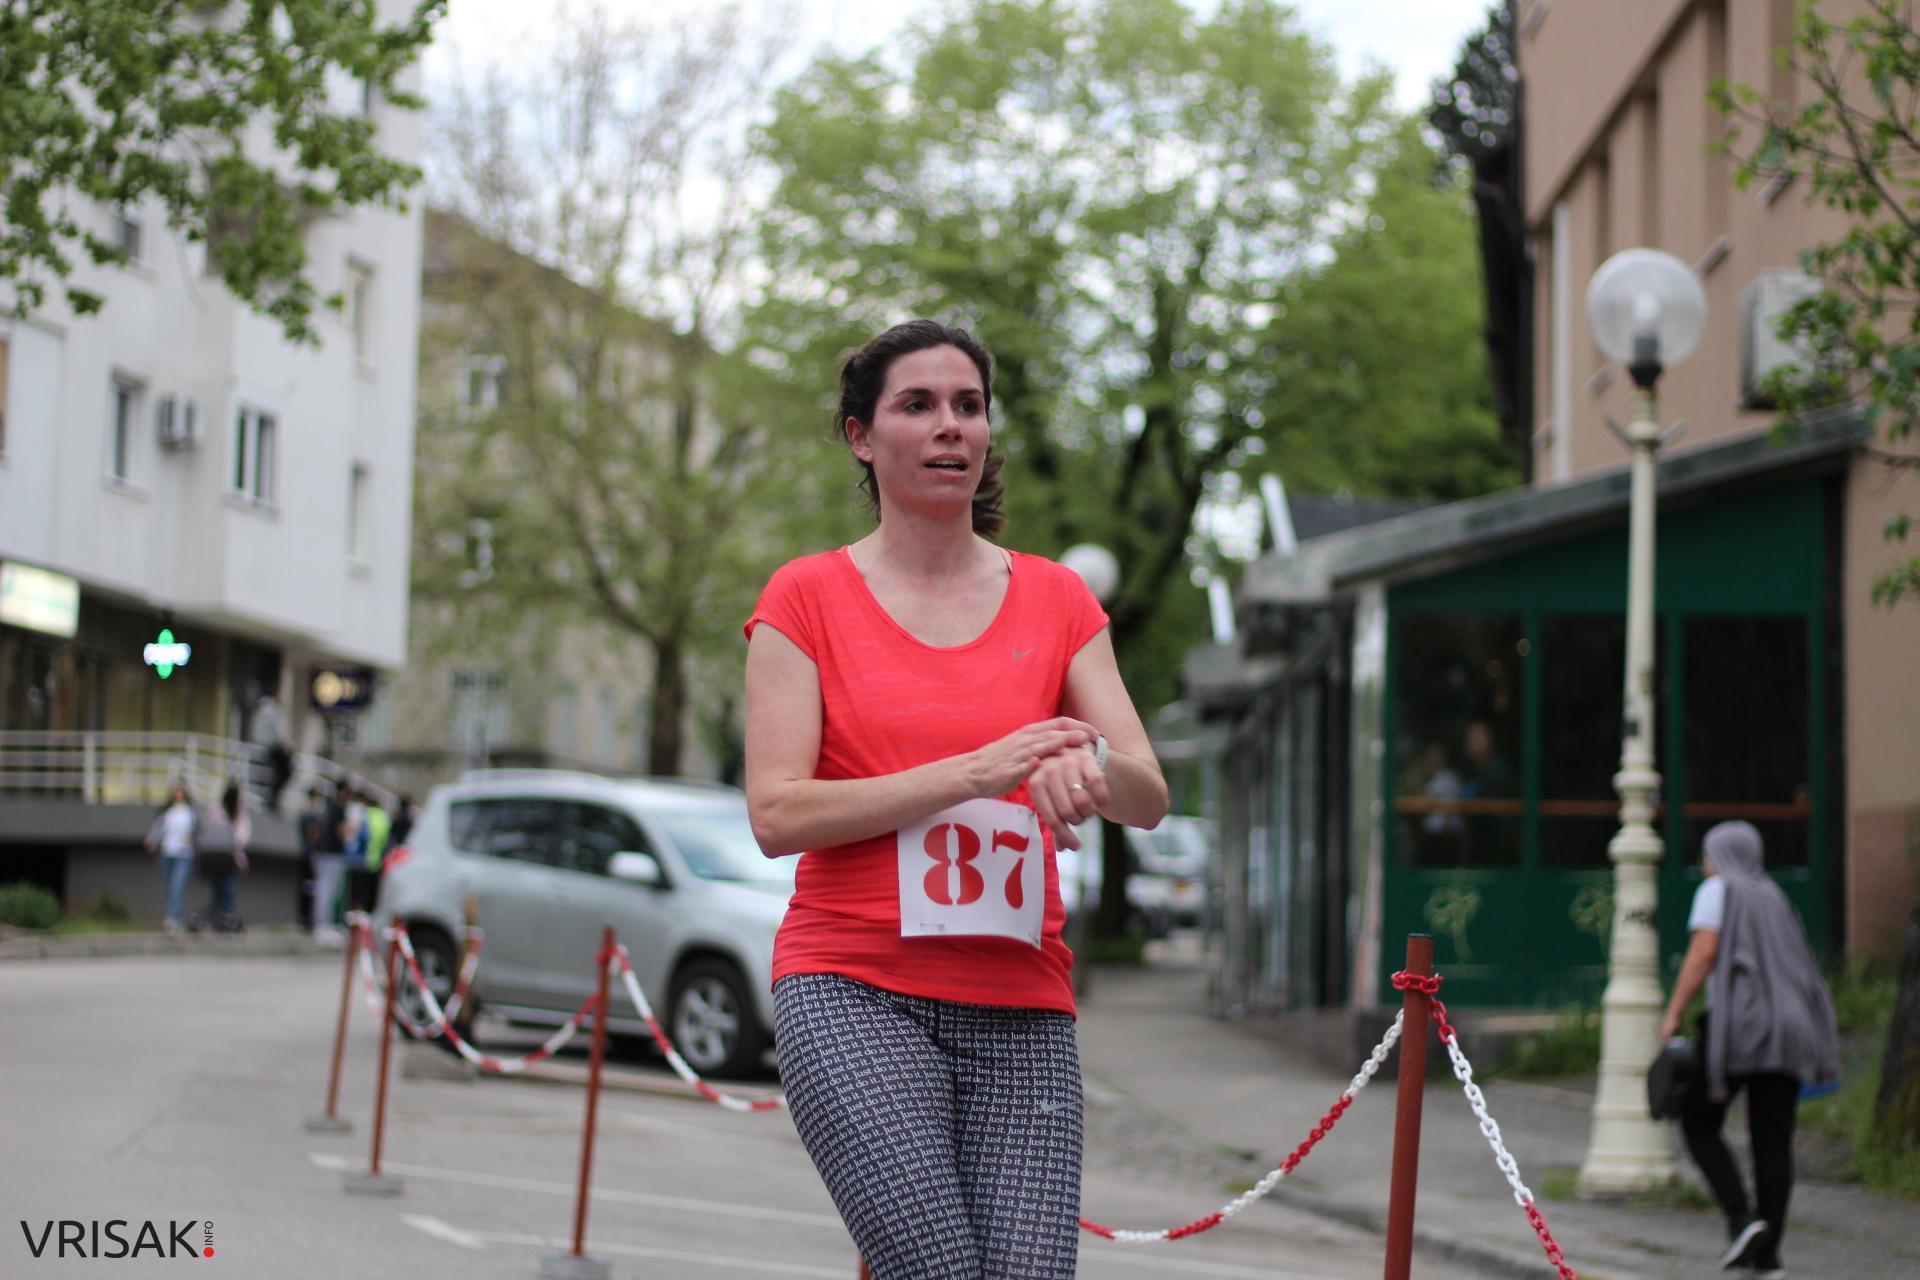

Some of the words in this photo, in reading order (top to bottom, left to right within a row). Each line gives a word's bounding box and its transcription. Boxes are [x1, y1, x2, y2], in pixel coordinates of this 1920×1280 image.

[923, 822, 1029, 910] 87
[798, 984, 809, 992] do
[819, 981, 836, 991] Just
[799, 975, 814, 985] Just
[823, 999, 841, 1009] Just
[841, 997, 854, 1005] do
[806, 1010, 823, 1021] Just
[824, 1008, 836, 1016] do
[847, 1005, 864, 1015] Just
[865, 1004, 877, 1012] do
[807, 1020, 818, 1029] do
[829, 1016, 847, 1026] Just
[848, 1014, 860, 1022] do
[870, 1013, 888, 1022] Just
[812, 1028, 829, 1040] Just
[830, 1026, 842, 1034] do
[853, 1022, 872, 1031] Just
[813, 1039, 825, 1048] do
[835, 1033, 854, 1044] Just
[855, 1030, 868, 1039] do
[879, 1029, 897, 1038] Just
[974, 1031, 989, 1040] Just
[990, 1031, 1001, 1039] do
[1010, 1032, 1026, 1041] Just
[1027, 1032, 1038, 1040] do
[1048, 1032, 1062, 1042] Just
[818, 1046, 837, 1059] Just
[837, 1043, 850, 1052] do
[861, 1038, 882, 1048] Just
[904, 1036, 922, 1044] Just
[957, 1040, 972, 1048] Just
[973, 1040, 984, 1048] do
[993, 1041, 1007, 1050] Just
[1008, 1041, 1020, 1050] do
[1030, 1041, 1046, 1051] Just
[1047, 1042, 1058, 1050] do
[820, 1058, 833, 1067] do
[843, 1050, 864, 1062] Just
[864, 1047, 878, 1056] do
[888, 1045, 908, 1054] Just
[907, 1044, 920, 1052] do
[992, 1050, 1003, 1058] do
[1012, 1051, 1027, 1060] Just
[1028, 1051, 1040, 1059] do
[1050, 1050, 1064, 1060] Just
[826, 1064, 846, 1078] Just
[846, 1061, 859, 1070] do
[870, 1055, 891, 1066] Just
[891, 1054, 904, 1062] do
[914, 1052, 931, 1062] Just
[829, 1077, 842, 1086] do
[852, 1068, 873, 1080] Just
[873, 1065, 887, 1073] do
[897, 1062, 917, 1072] Just
[991, 1068, 1002, 1076] do
[1012, 1069, 1028, 1079] Just
[1030, 1069, 1042, 1077] do
[1051, 1069, 1065, 1078] Just
[972, 1075, 984, 1083] do
[994, 1076, 1010, 1086] Just
[1011, 1078, 1022, 1086] do
[1032, 1078, 1049, 1088] Just
[1050, 1078, 1060, 1087] do
[974, 1084, 990, 1094] Just
[991, 1086, 1002, 1094] do
[1012, 1087, 1029, 1097] Just
[1030, 1087, 1042, 1096] do
[1052, 1088, 1065, 1098] Just
[845, 1101, 865, 1115] Just
[865, 1097, 879, 1106] do
[890, 1091, 910, 1102] Just
[910, 1089, 922, 1098] do
[965, 1112, 977, 1121] do
[986, 1114, 1005, 1124] Just
[1006, 1116, 1019, 1125] do
[1029, 1116, 1048, 1127] Just
[1048, 1118, 1060, 1127] do
[866, 1138, 885, 1152] Just
[886, 1135, 899, 1144] do
[910, 1128, 928, 1139] Just
[982, 1134, 1002, 1144] Just
[1002, 1136, 1016, 1144] do
[1027, 1137, 1045, 1147] Just
[1046, 1138, 1058, 1147] do
[979, 1154, 997, 1164] Just
[999, 1156, 1012, 1164] do
[1024, 1157, 1043, 1168] Just
[1044, 1159, 1056, 1168] do
[862, 1174, 880, 1188] Just
[880, 1170, 893, 1180] do
[903, 1160, 922, 1174] Just
[976, 1174, 994, 1185] Just
[995, 1176, 1009, 1185] do
[1021, 1178, 1040, 1189] Just
[1042, 1181, 1054, 1190] do
[992, 1197, 1006, 1206] do
[1017, 1199, 1037, 1210] Just
[1038, 1202, 1052, 1212] do
[988, 1218, 1002, 1227] do
[1013, 1220, 1034, 1232] Just
[1035, 1224, 1049, 1233] do
[985, 1239, 998, 1248] do
[1009, 1242, 1030, 1254] Just
[1031, 1245, 1045, 1255] do
